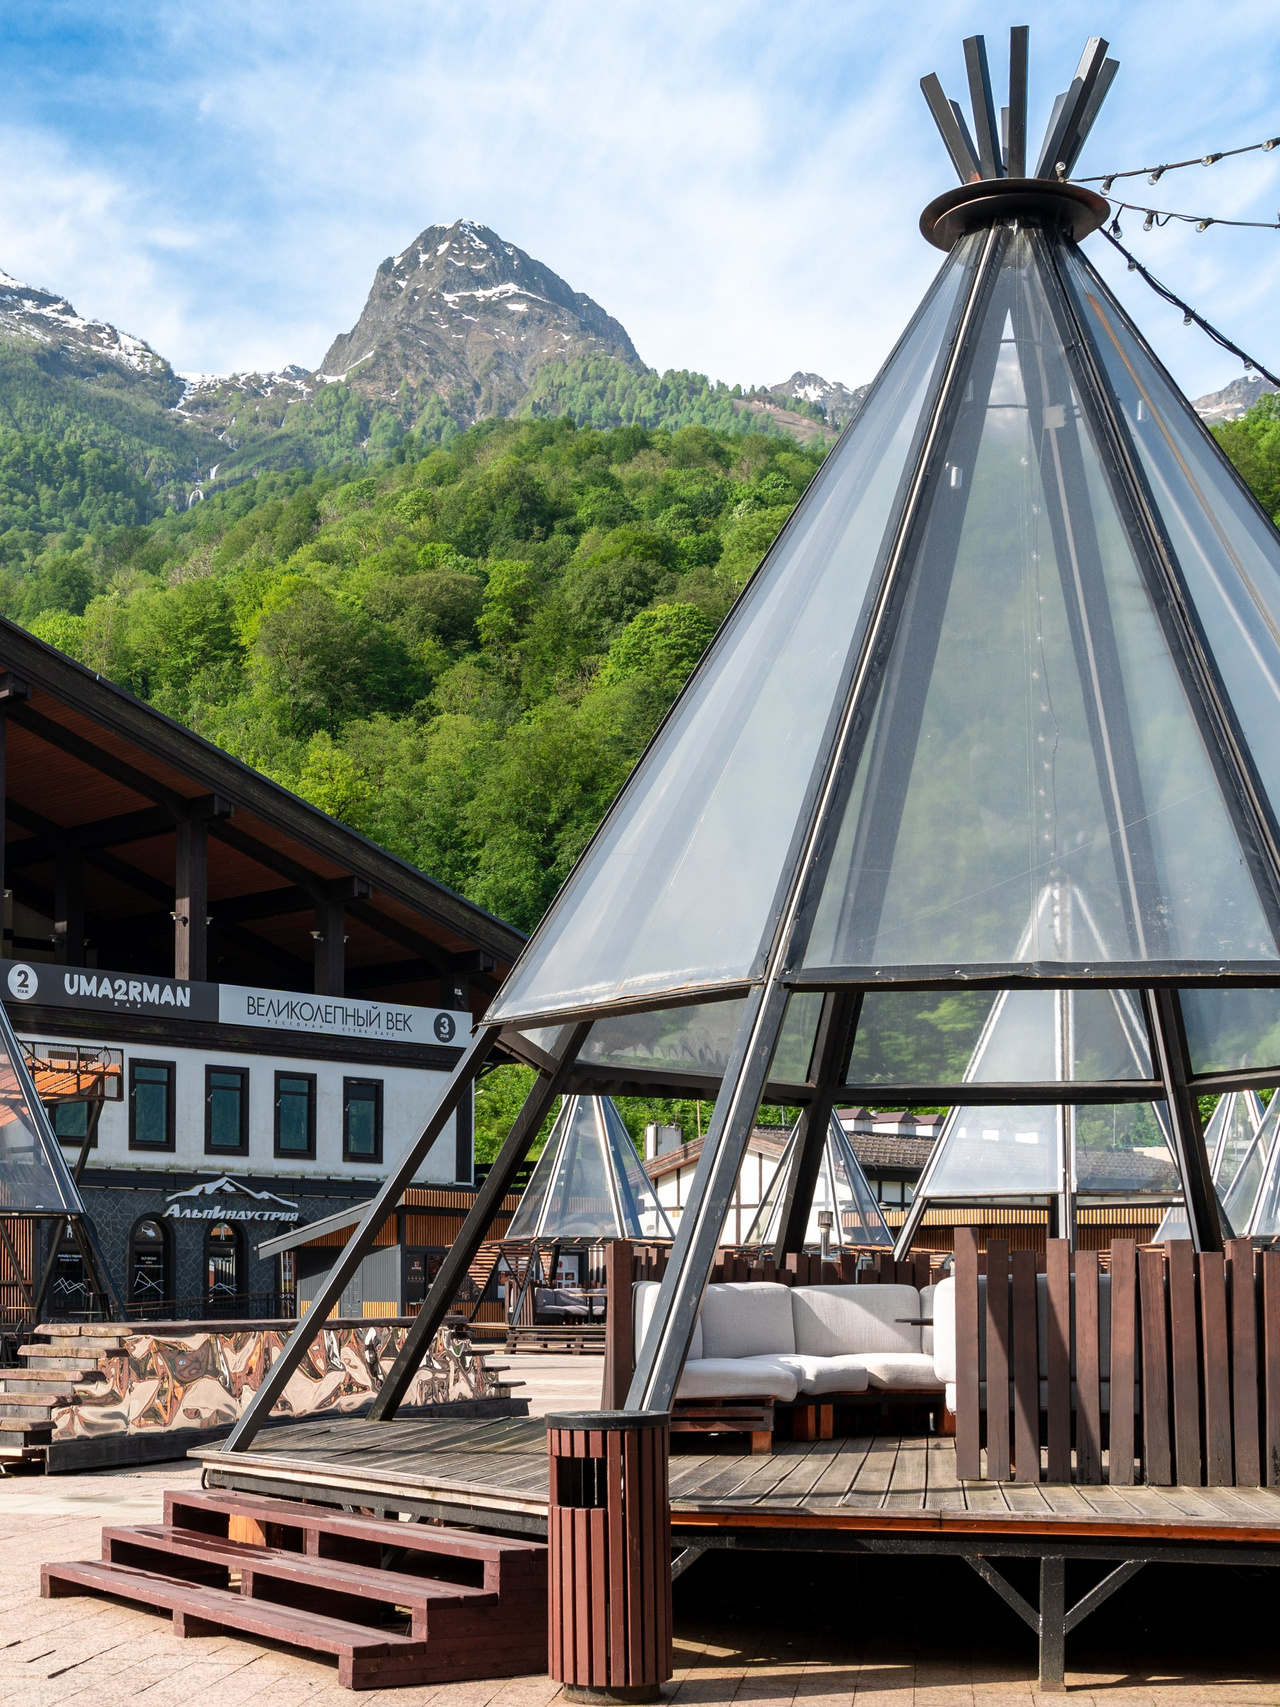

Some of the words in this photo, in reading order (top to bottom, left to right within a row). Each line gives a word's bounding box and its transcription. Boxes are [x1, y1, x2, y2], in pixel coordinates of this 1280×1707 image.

[17, 969, 29, 989] 2
[63, 973, 191, 1007] UMA2RMAN
[247, 996, 381, 1029] ВЕЛИКОЛЕПНЫЙ
[386, 1011, 413, 1032] ВЕК
[267, 1020, 323, 1029] РЕСТОРАН
[439, 1017, 450, 1034] 3
